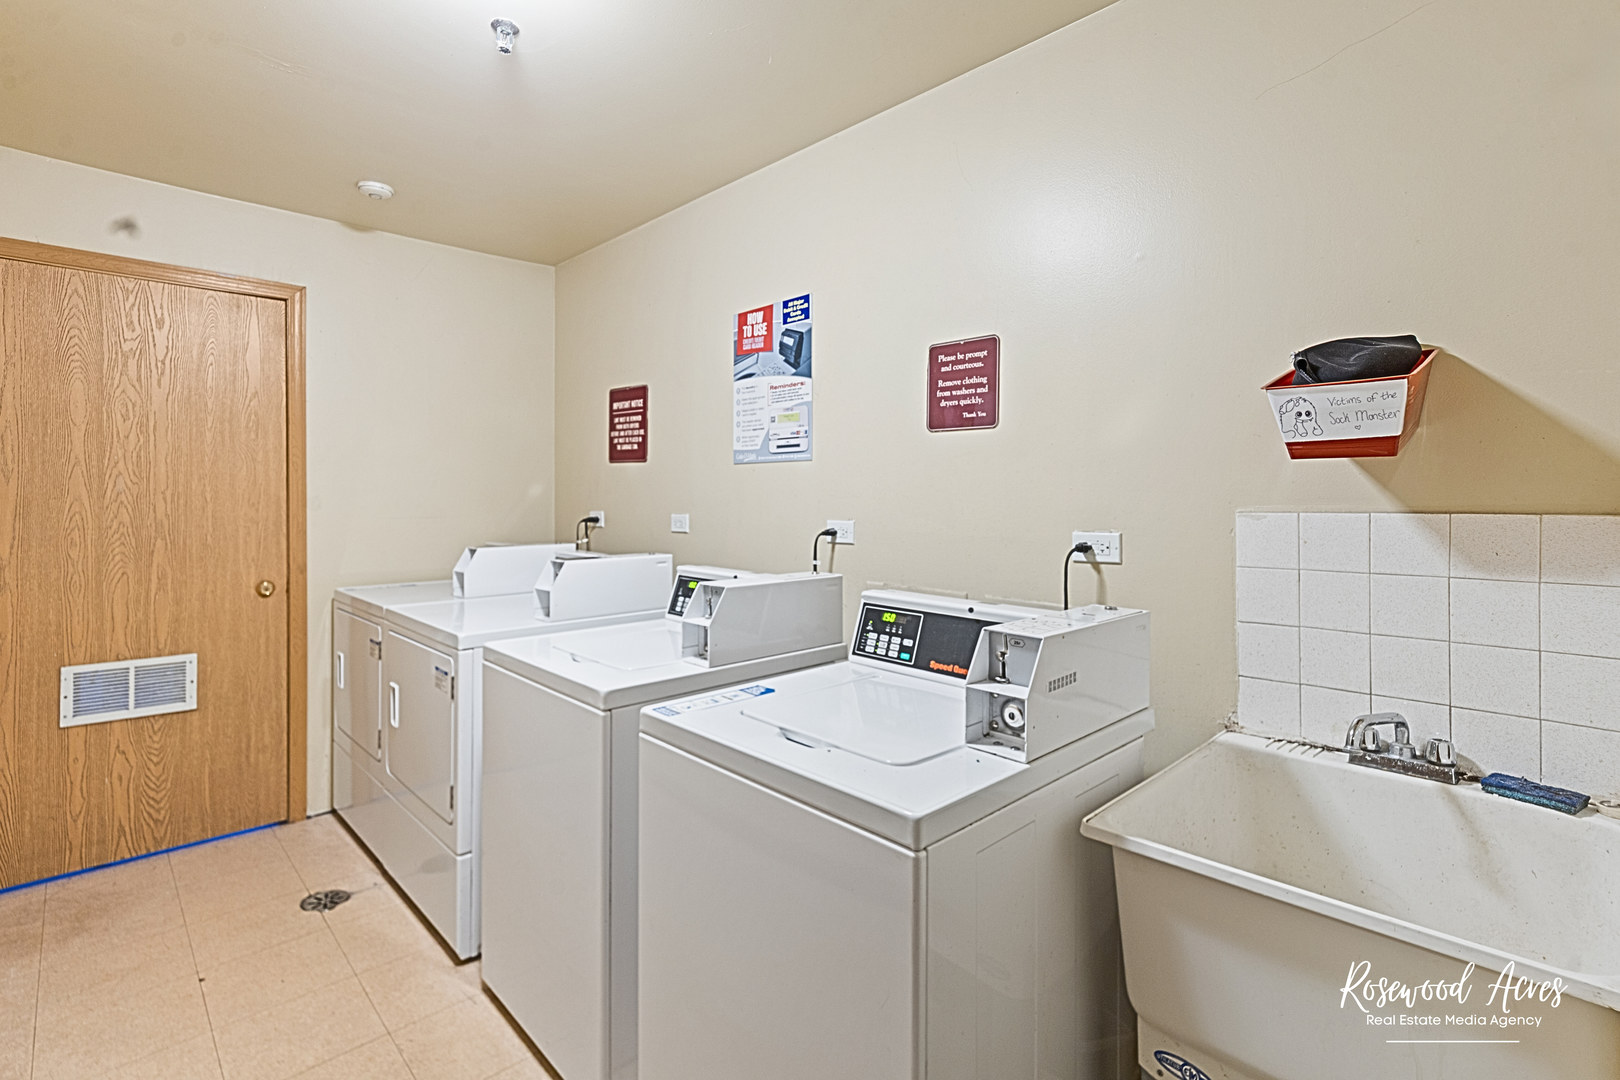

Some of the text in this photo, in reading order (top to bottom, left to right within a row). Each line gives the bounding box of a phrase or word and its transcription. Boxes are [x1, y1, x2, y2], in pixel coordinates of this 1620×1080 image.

[747, 311, 764, 325] HOW
[743, 322, 767, 338] TO USE
[938, 350, 988, 362] Please be prompt
[953, 362, 984, 370] courteous.
[770, 381, 806, 390] Reminders:
[962, 376, 988, 385] clothing
[952, 387, 975, 395] washers
[976, 385, 988, 393] and
[940, 396, 984, 407] dryers quickly.
[1326, 391, 1397, 407] Victims of the
[1329, 409, 1400, 425] Sock Monster
[930, 660, 953, 672] Speed
